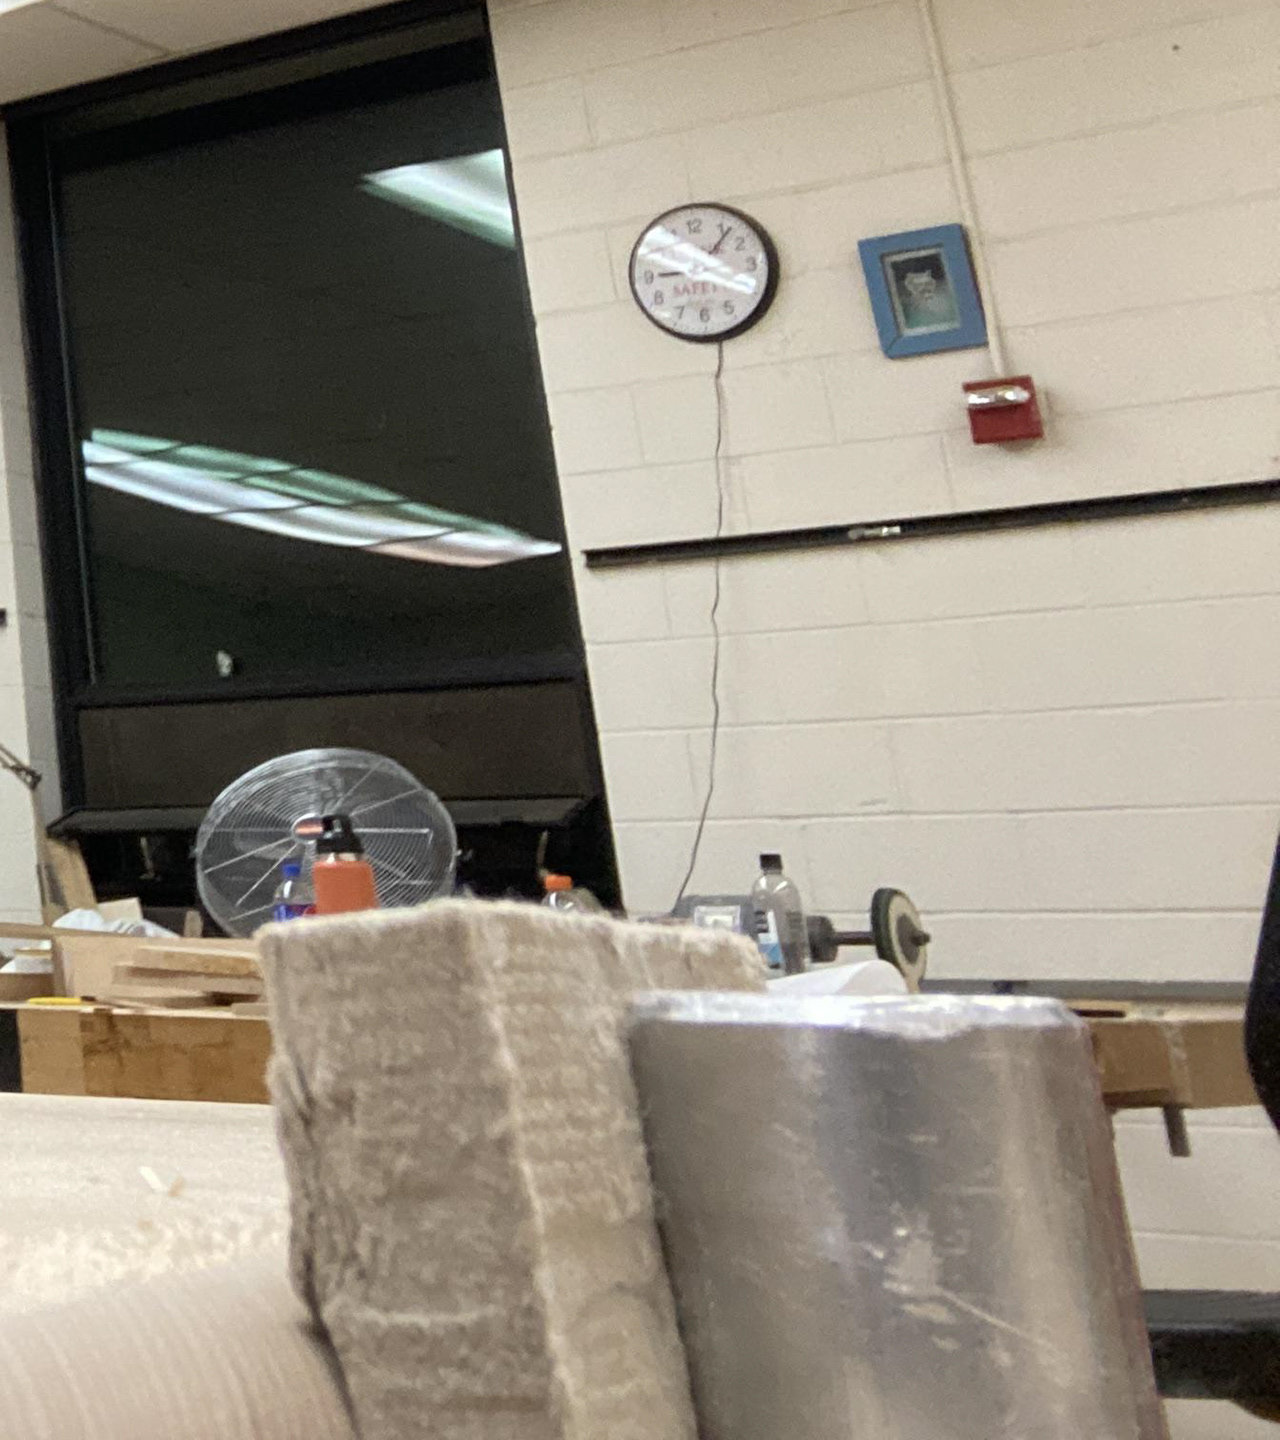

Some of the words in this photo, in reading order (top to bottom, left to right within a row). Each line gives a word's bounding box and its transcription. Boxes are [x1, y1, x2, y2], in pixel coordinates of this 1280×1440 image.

[686, 218, 703, 235] 12
[735, 237, 746, 252] 2
[746, 257, 757, 272] 3
[643, 269, 654, 285] 9
[654, 290, 664, 306] 8
[674, 305, 685, 320] 7
[699, 307, 710, 323] 6
[723, 300, 734, 315] 5
